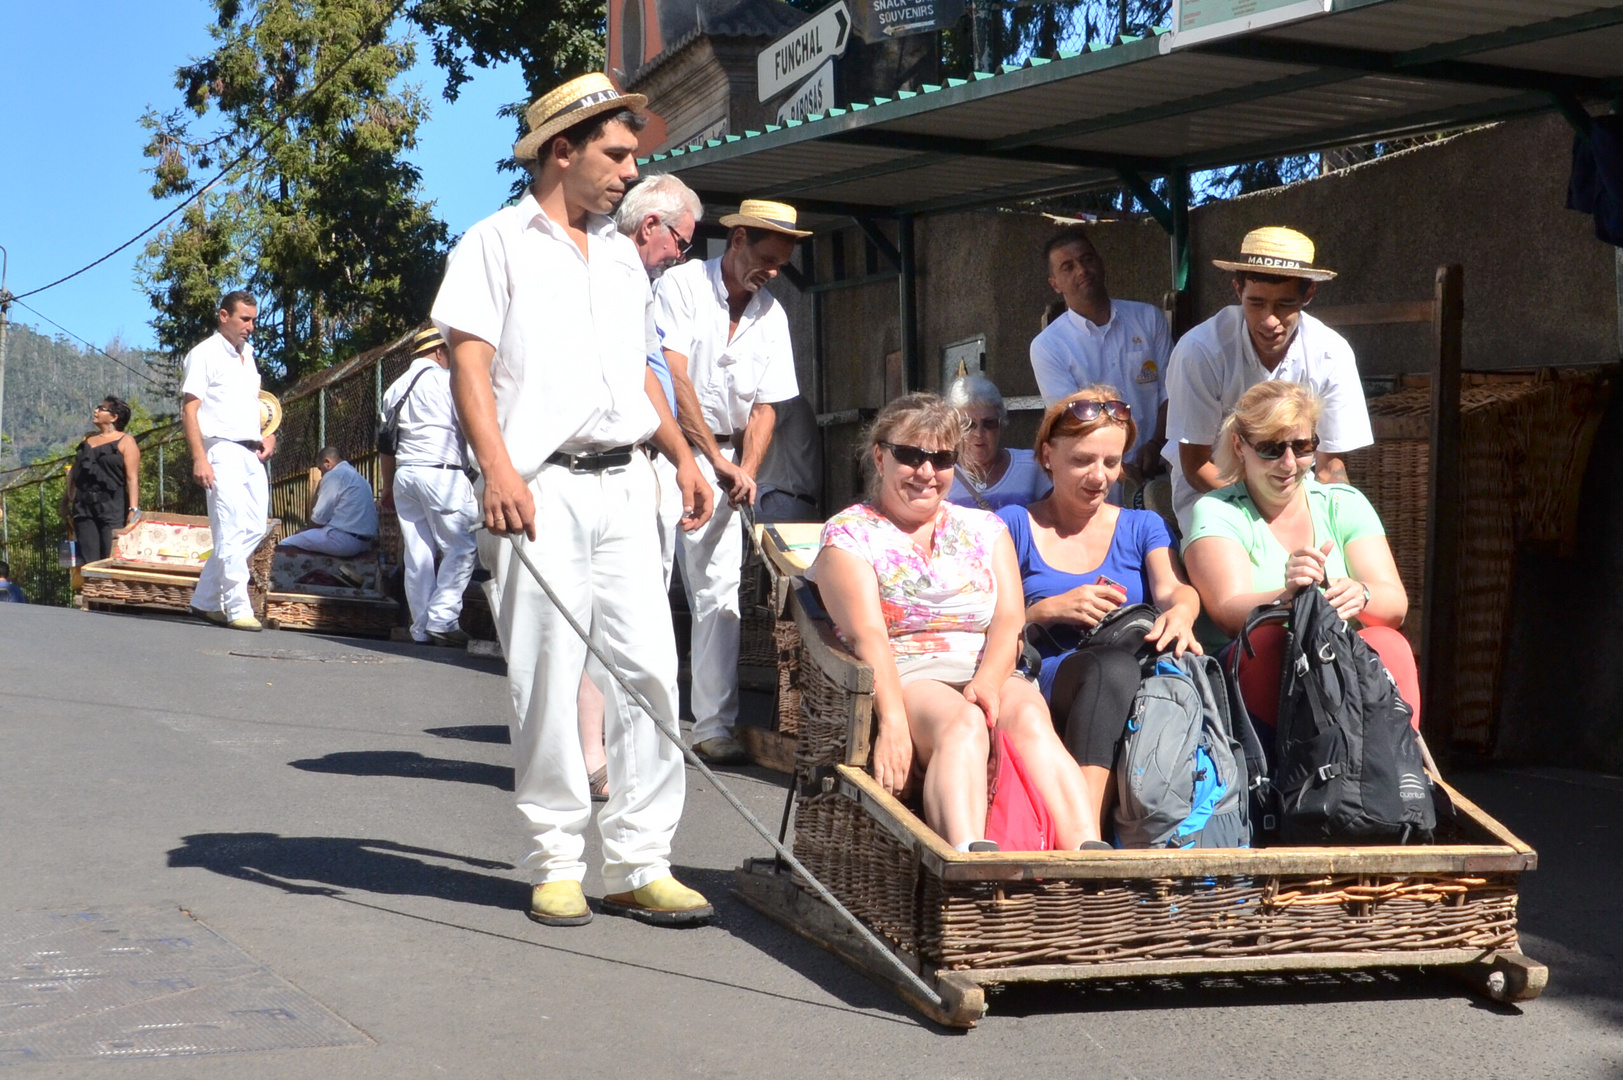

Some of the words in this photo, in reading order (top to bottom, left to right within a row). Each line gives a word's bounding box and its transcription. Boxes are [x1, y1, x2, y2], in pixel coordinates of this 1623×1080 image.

[878, 5, 934, 24] SOUVENIRS
[775, 26, 822, 80] FUNCHAL
[1248, 256, 1301, 269] MADEIRA
